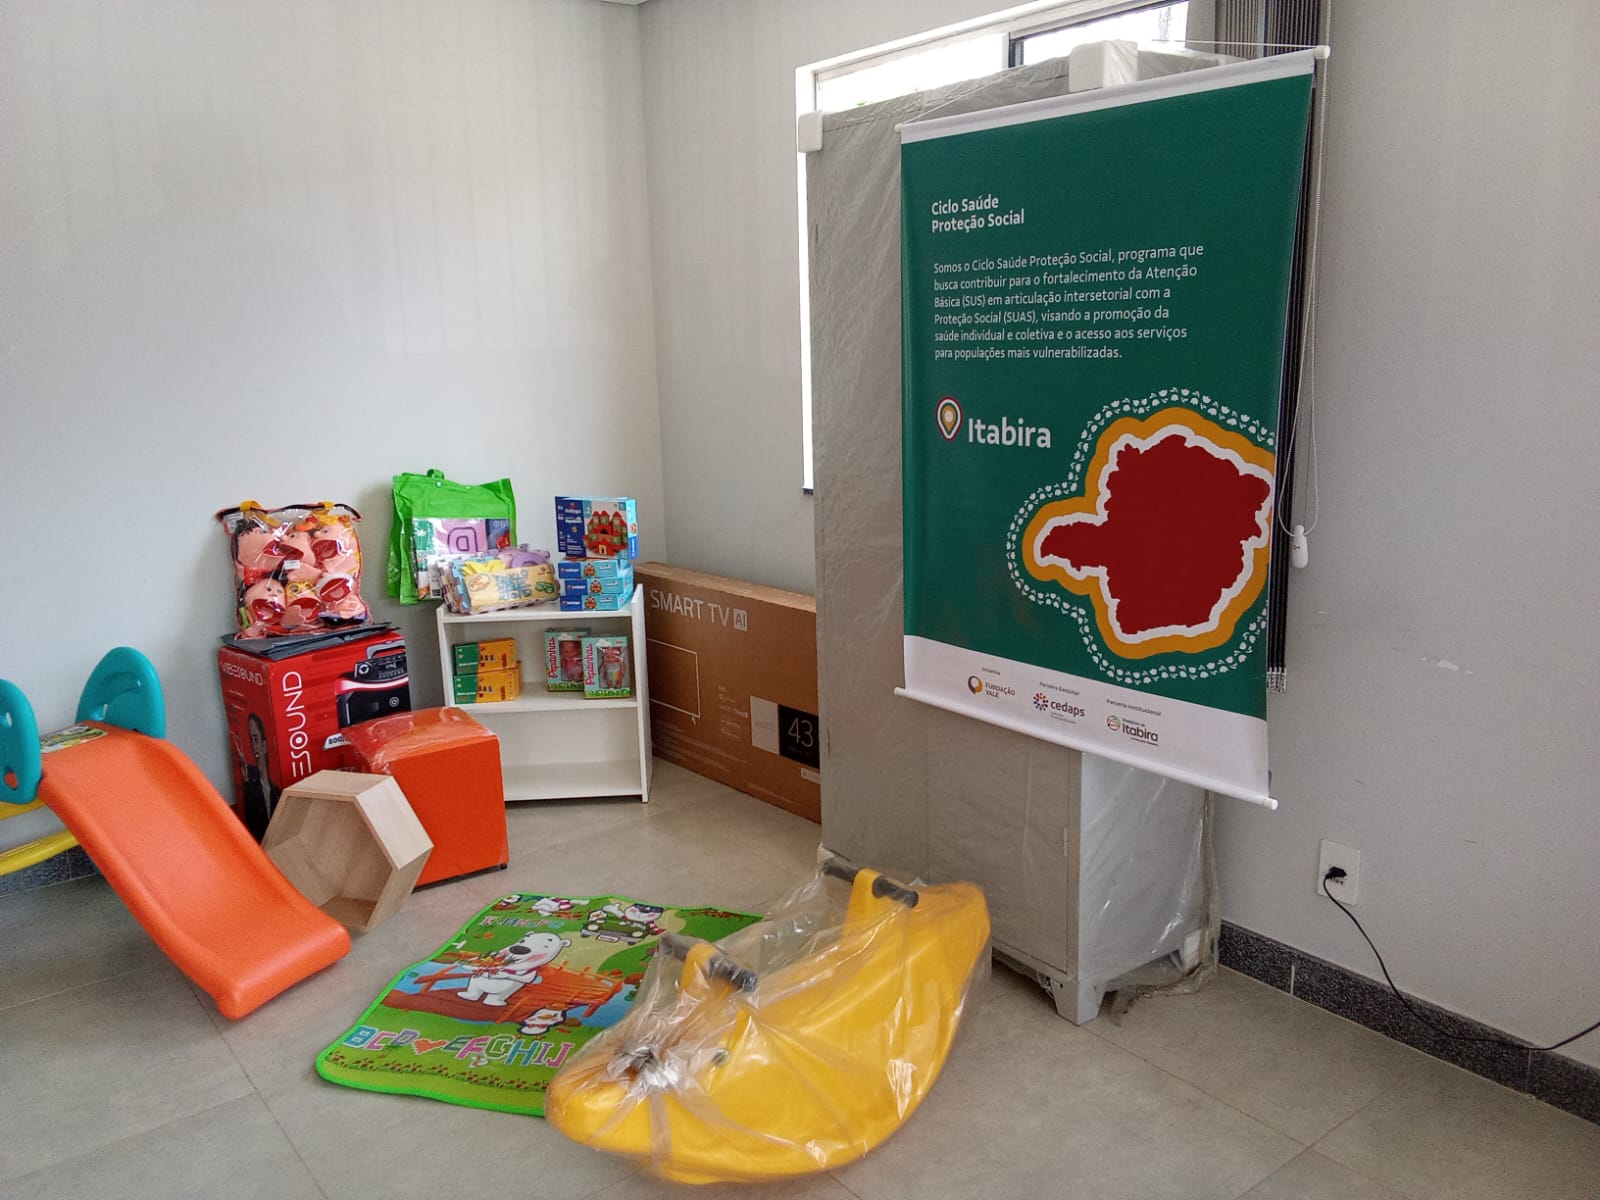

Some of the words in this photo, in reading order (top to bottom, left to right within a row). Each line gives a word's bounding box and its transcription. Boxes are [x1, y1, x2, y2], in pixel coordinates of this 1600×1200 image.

[931, 198, 959, 216] Ciclo
[961, 194, 999, 213] Saúde
[932, 214, 985, 234] Proteção
[987, 208, 1025, 228] Social
[933, 262, 962, 274] Somos
[964, 263, 970, 272] o
[971, 258, 995, 272] Ciclo
[996, 256, 1027, 270] Saúde
[1029, 252, 1077, 269] Proteção
[1079, 248, 1115, 264] Social,
[1118, 246, 1176, 265] programa
[1179, 245, 1204, 260] que
[934, 279, 959, 291] busca
[960, 276, 1007, 289] contribuir
[1009, 276, 1031, 290] para
[1033, 275, 1040, 286] o
[1043, 269, 1126, 285] fortalecimento
[1128, 266, 1142, 280] da
[1145, 264, 1198, 281] Atenção
[934, 296, 960, 308] Básica
[962, 294, 986, 308] (SUS)
[987, 296, 1002, 306] em
[1004, 291, 1061, 306] articulação
[1064, 286, 1133, 303] intersetorial
[1135, 288, 1160, 300] com
[1163, 287, 1171, 298] a
[934, 313, 973, 327] Proteção
[974, 311, 1002, 324] Social
[1003, 310, 1038, 325] (SUAS),
[1041, 308, 1081, 322] visando
[1084, 311, 1091, 321] a
[1093, 307, 1151, 324] promoção
[1154, 305, 1169, 319] da
[934, 330, 959, 341] saúde
[961, 328, 1005, 341] individual
[1007, 331, 1014, 340] e
[1015, 328, 1055, 341] coletiva
[1057, 331, 1064, 340] e
[1066, 330, 1073, 340] o
[1074, 329, 1112, 340] acesso
[1114, 328, 1134, 339] aos
[1136, 325, 1188, 341] serviços
[935, 349, 953, 360] para
[954, 347, 1005, 361] populações
[1007, 347, 1030, 358] mais
[1032, 345, 1122, 358] vulnerabilizadas.
[968, 416, 1051, 449] Itabira
[650, 589, 705, 621] SMART
[707, 602, 730, 627] TV
[985, 682, 1016, 697] FUNDAÇÃO
[985, 690, 999, 699] VALE
[1050, 700, 1086, 718] cedaps
[787, 717, 814, 748] 43
[1122, 722, 1159, 742] Itabira
